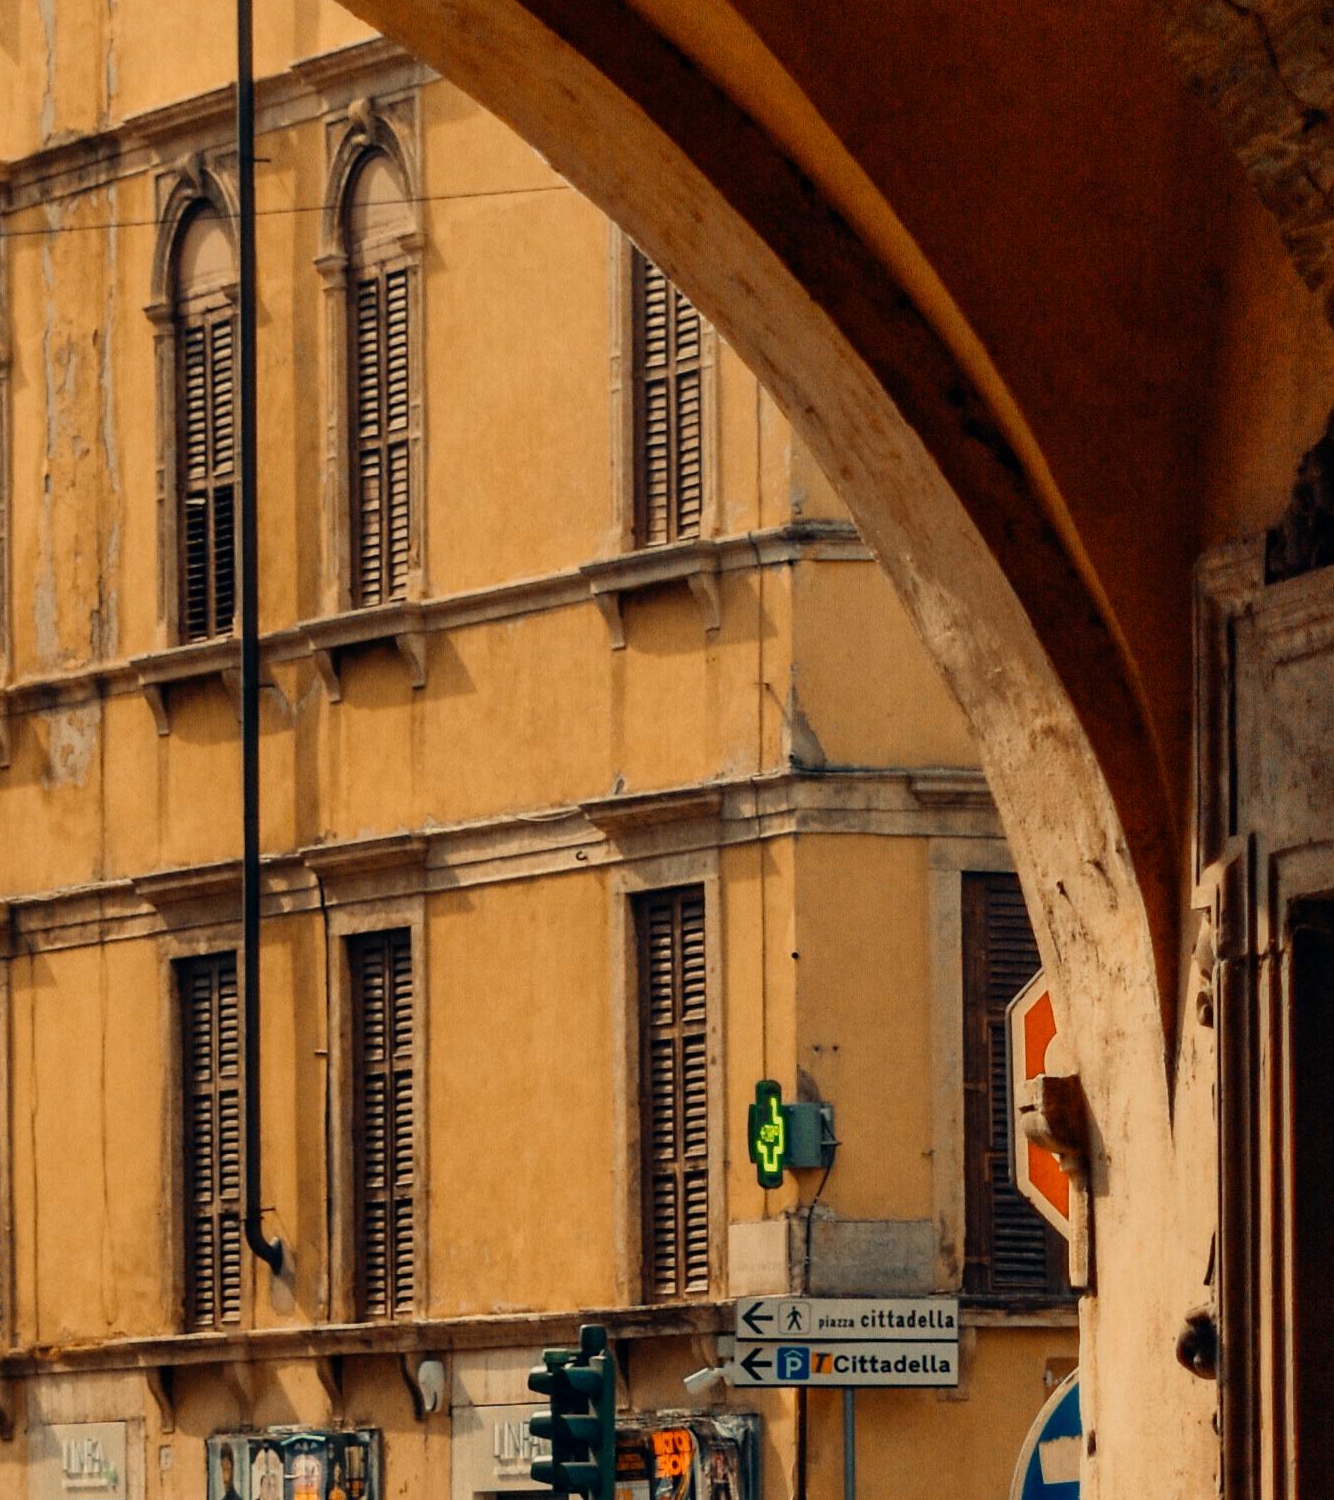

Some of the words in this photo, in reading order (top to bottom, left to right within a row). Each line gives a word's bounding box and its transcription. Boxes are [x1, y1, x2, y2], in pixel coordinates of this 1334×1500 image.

[818, 1316, 854, 1328] piazza
[860, 1308, 955, 1329] cittadella
[833, 1354, 951, 1374] Cittadella
